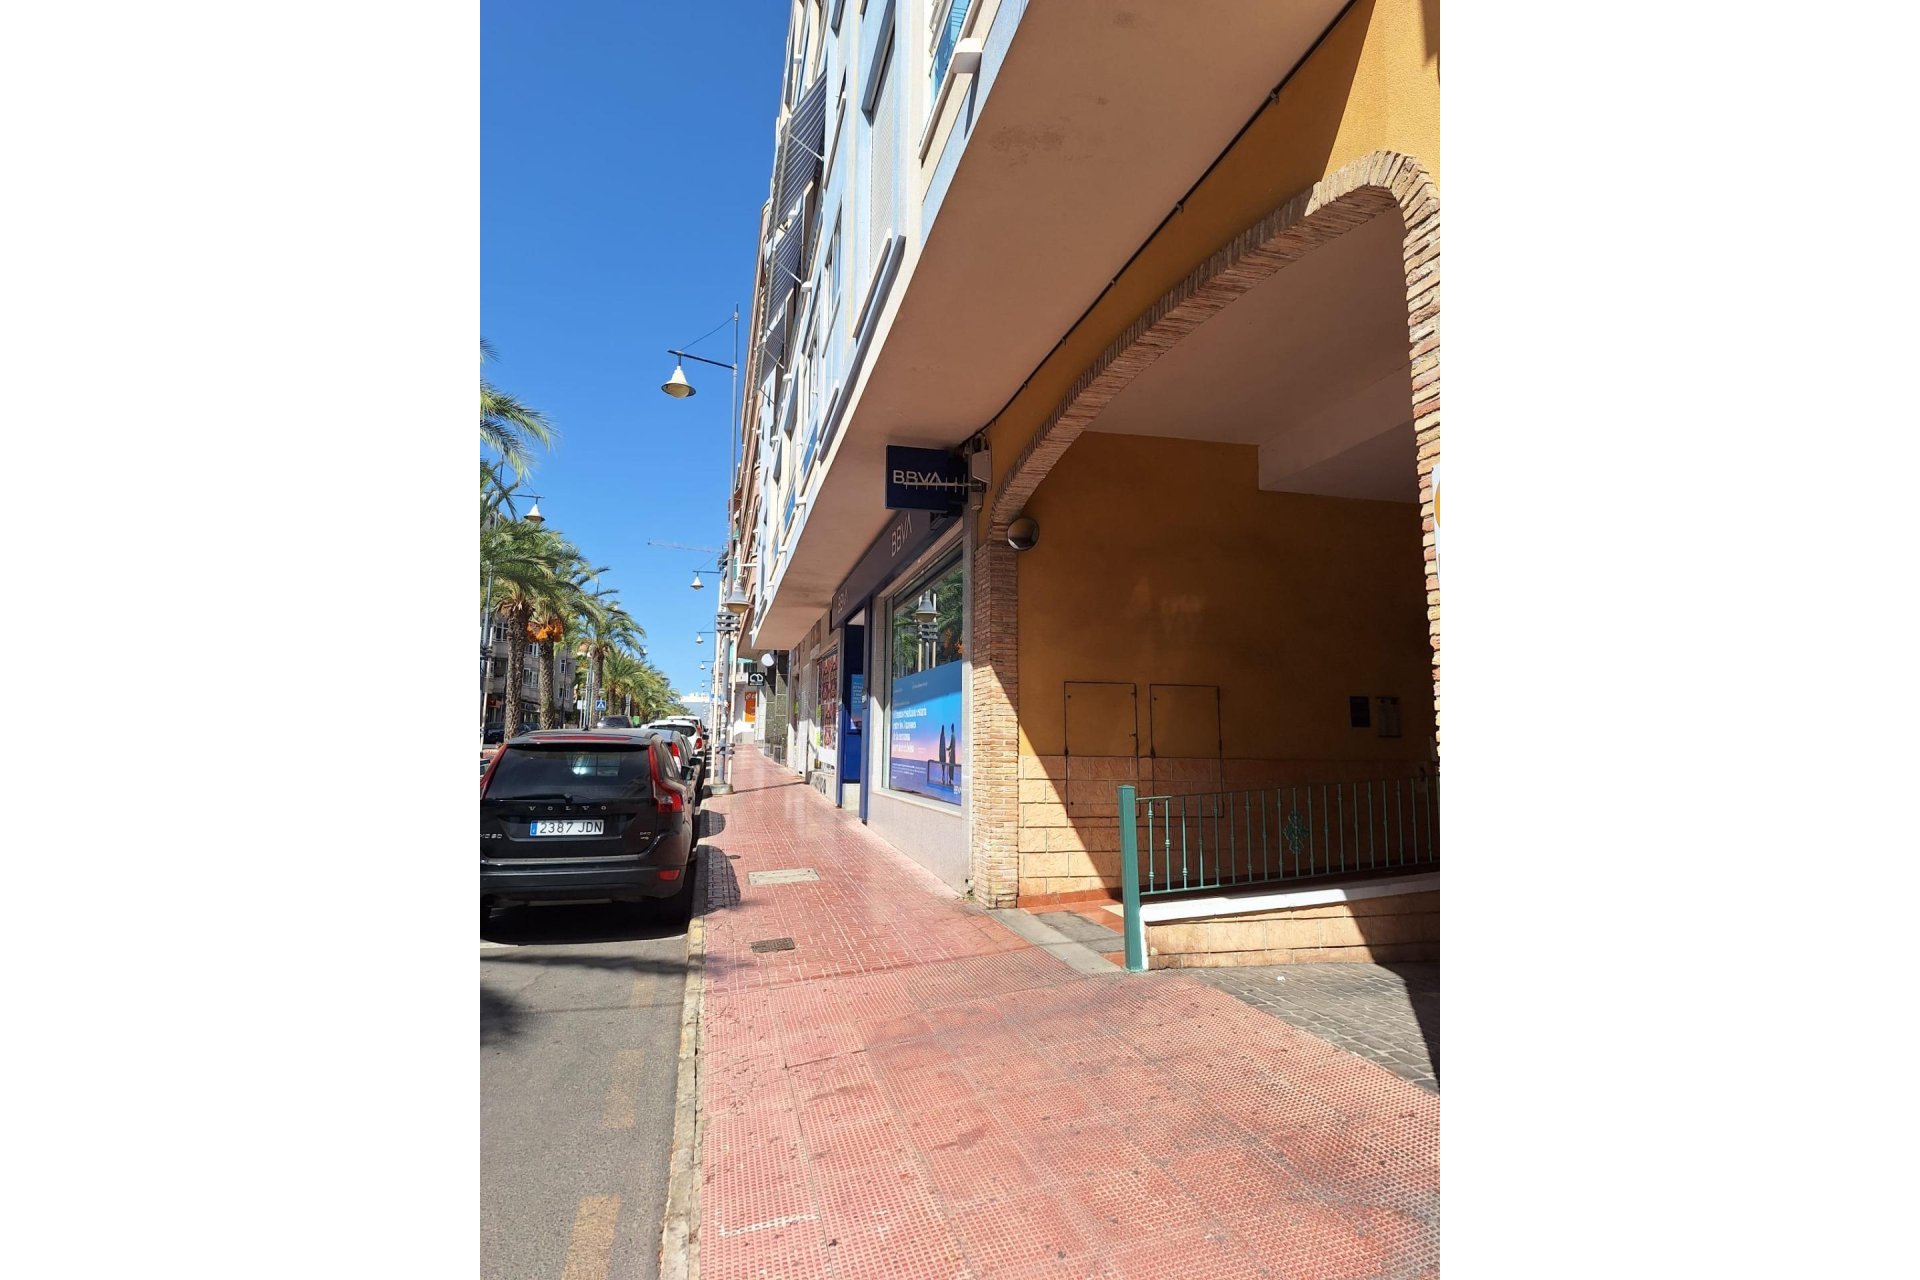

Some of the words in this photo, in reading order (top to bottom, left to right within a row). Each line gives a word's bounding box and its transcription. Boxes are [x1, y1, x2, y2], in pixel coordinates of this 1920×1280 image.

[893, 469, 942, 485] BBVA
[891, 512, 913, 558] BBVA
[539, 821, 574, 834] 2387
[577, 821, 603, 833] JDN
